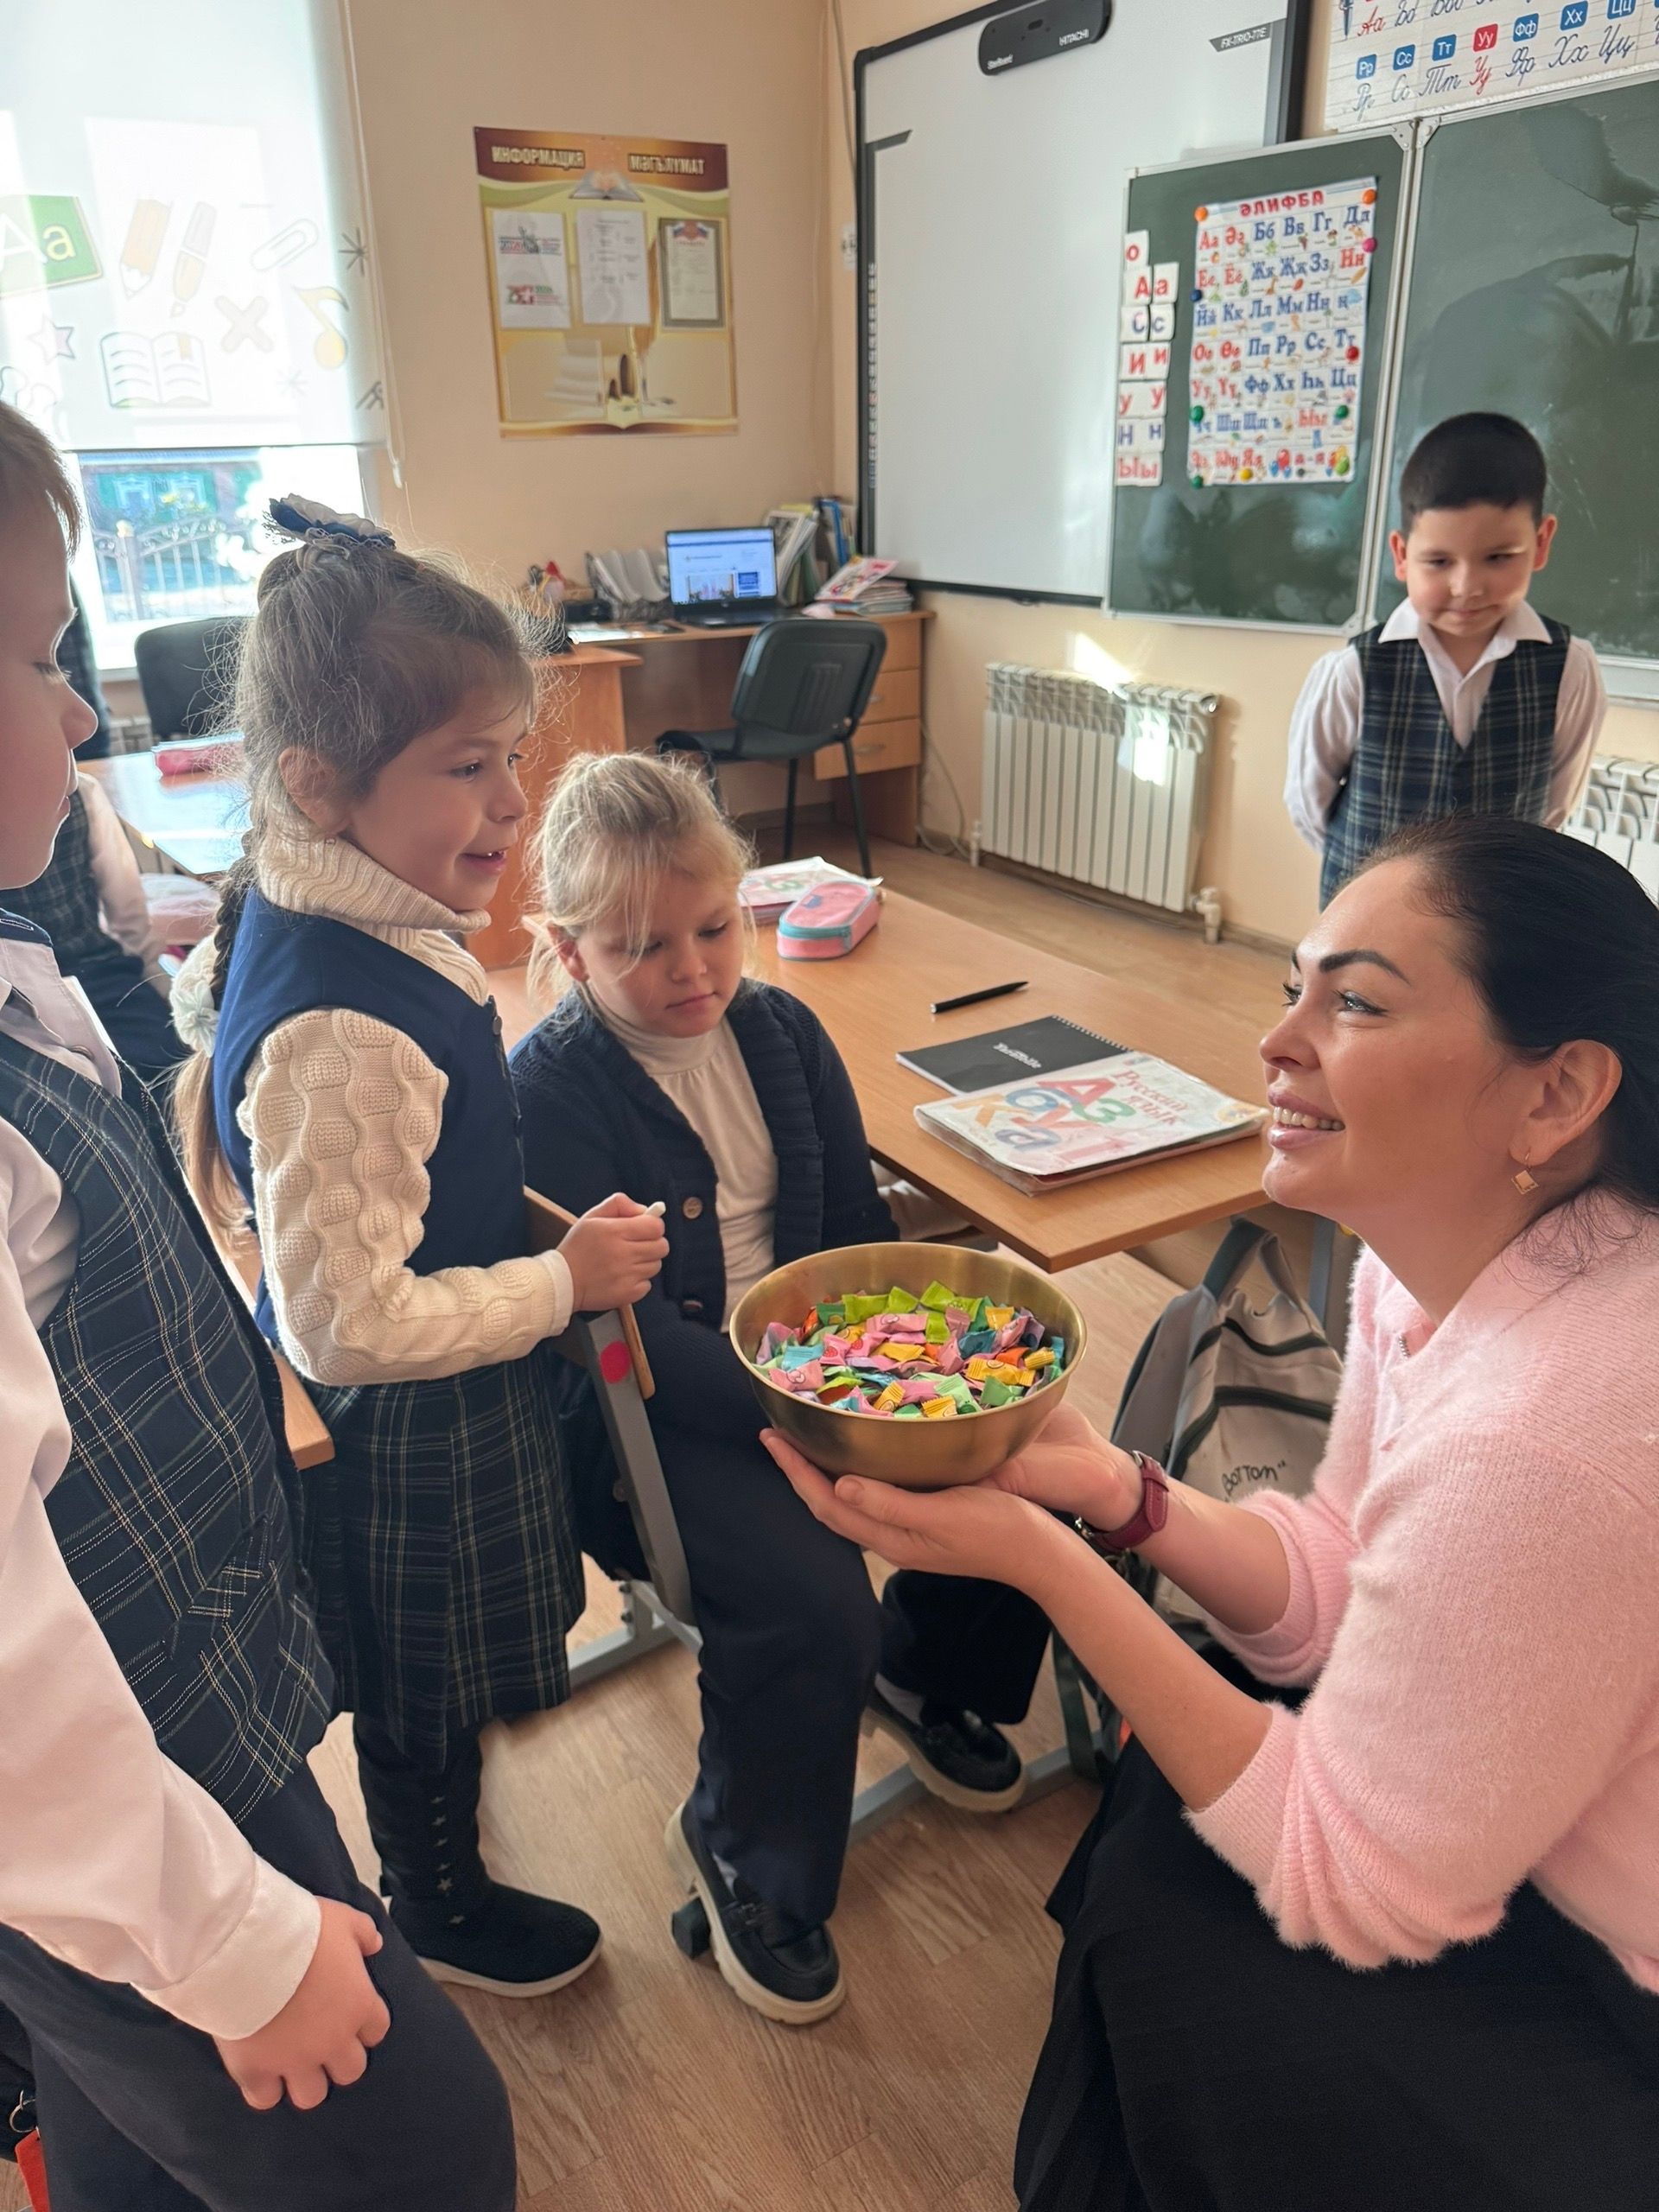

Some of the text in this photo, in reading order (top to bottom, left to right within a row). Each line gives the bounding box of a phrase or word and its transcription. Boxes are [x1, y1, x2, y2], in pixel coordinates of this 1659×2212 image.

[1059, 29, 1090, 46] HITACHI
[1359, 61, 1373, 78] Рр
[1396, 52, 1413, 66] Сс
[1438, 42, 1452, 56] Тт
[1478, 32, 1494, 48] Уу
[1515, 21, 1536, 37] Фф
[1565, 9, 1583, 26] Хх
[492, 146, 584, 170] ИНФОРМАЦИЯ
[1255, 221, 1274, 241] Бб
[1284, 217, 1305, 237] Вв
[1313, 212, 1332, 232] Гг
[1344, 206, 1370, 228] Дд
[1310, 252, 1330, 273] Зз
[1224, 303, 1244, 322] Кк
[1306, 332, 1325, 350] Сс
